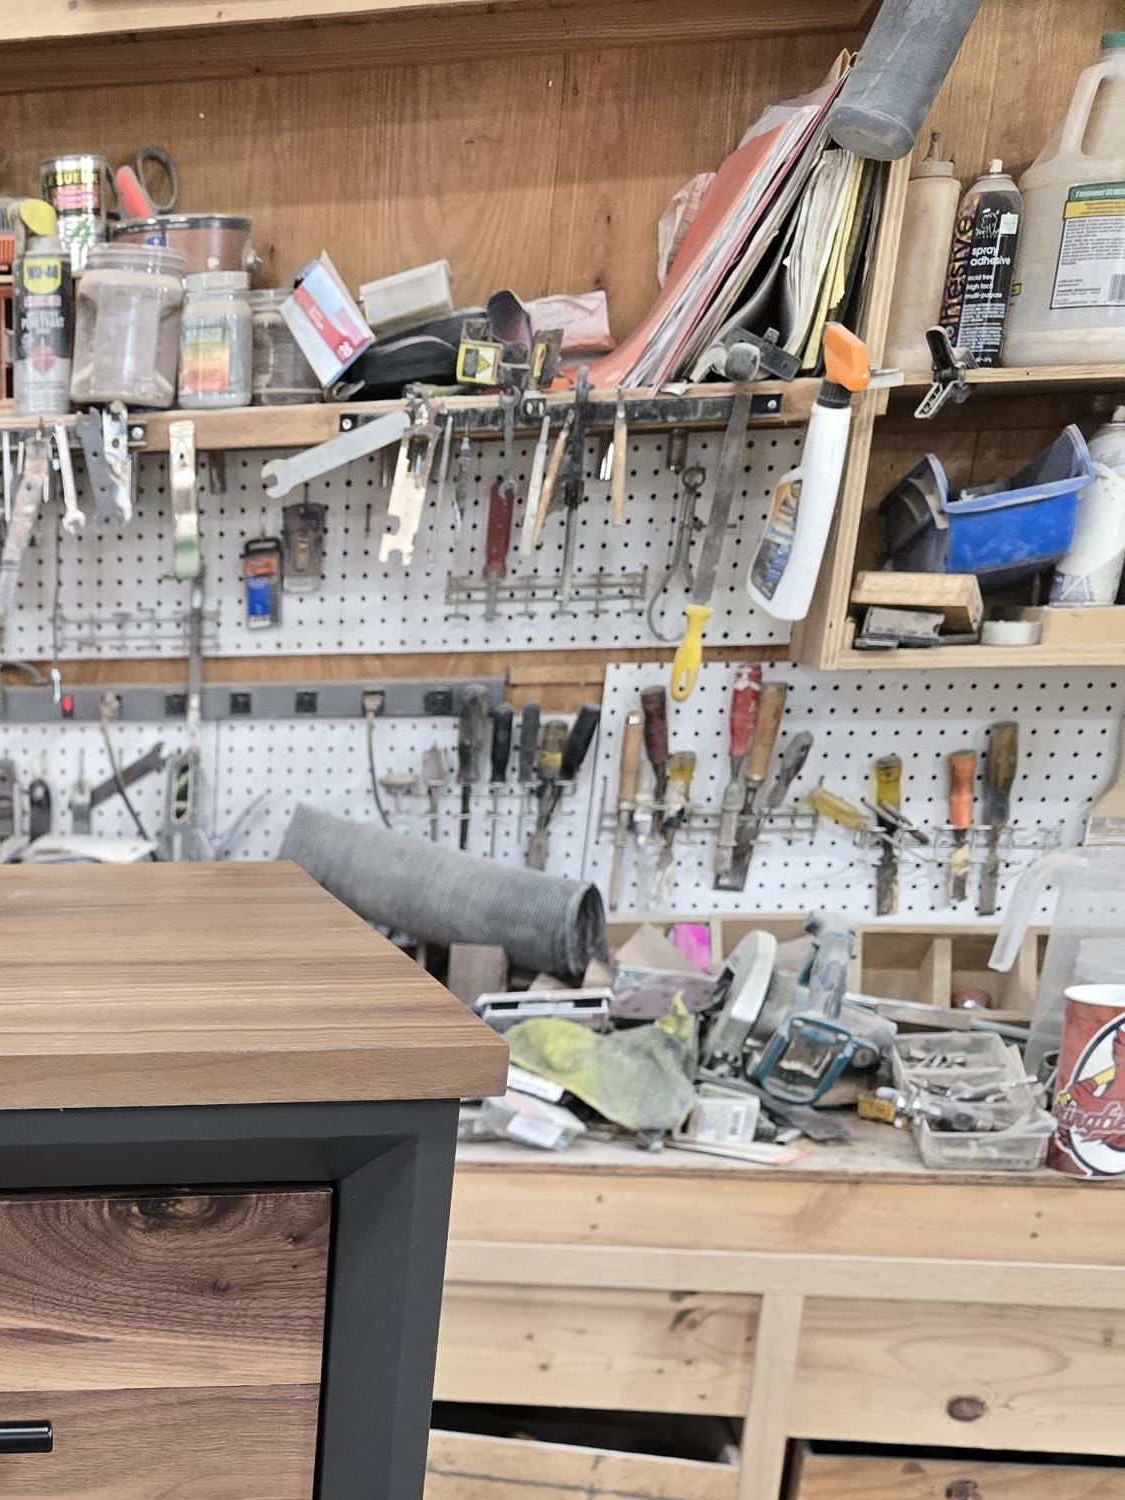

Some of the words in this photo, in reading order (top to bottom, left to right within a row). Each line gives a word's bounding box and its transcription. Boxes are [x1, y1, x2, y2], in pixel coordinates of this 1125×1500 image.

[971, 245, 999, 257] spray
[970, 255, 1011, 267] adhesive
[939, 215, 973, 338] dhesive
